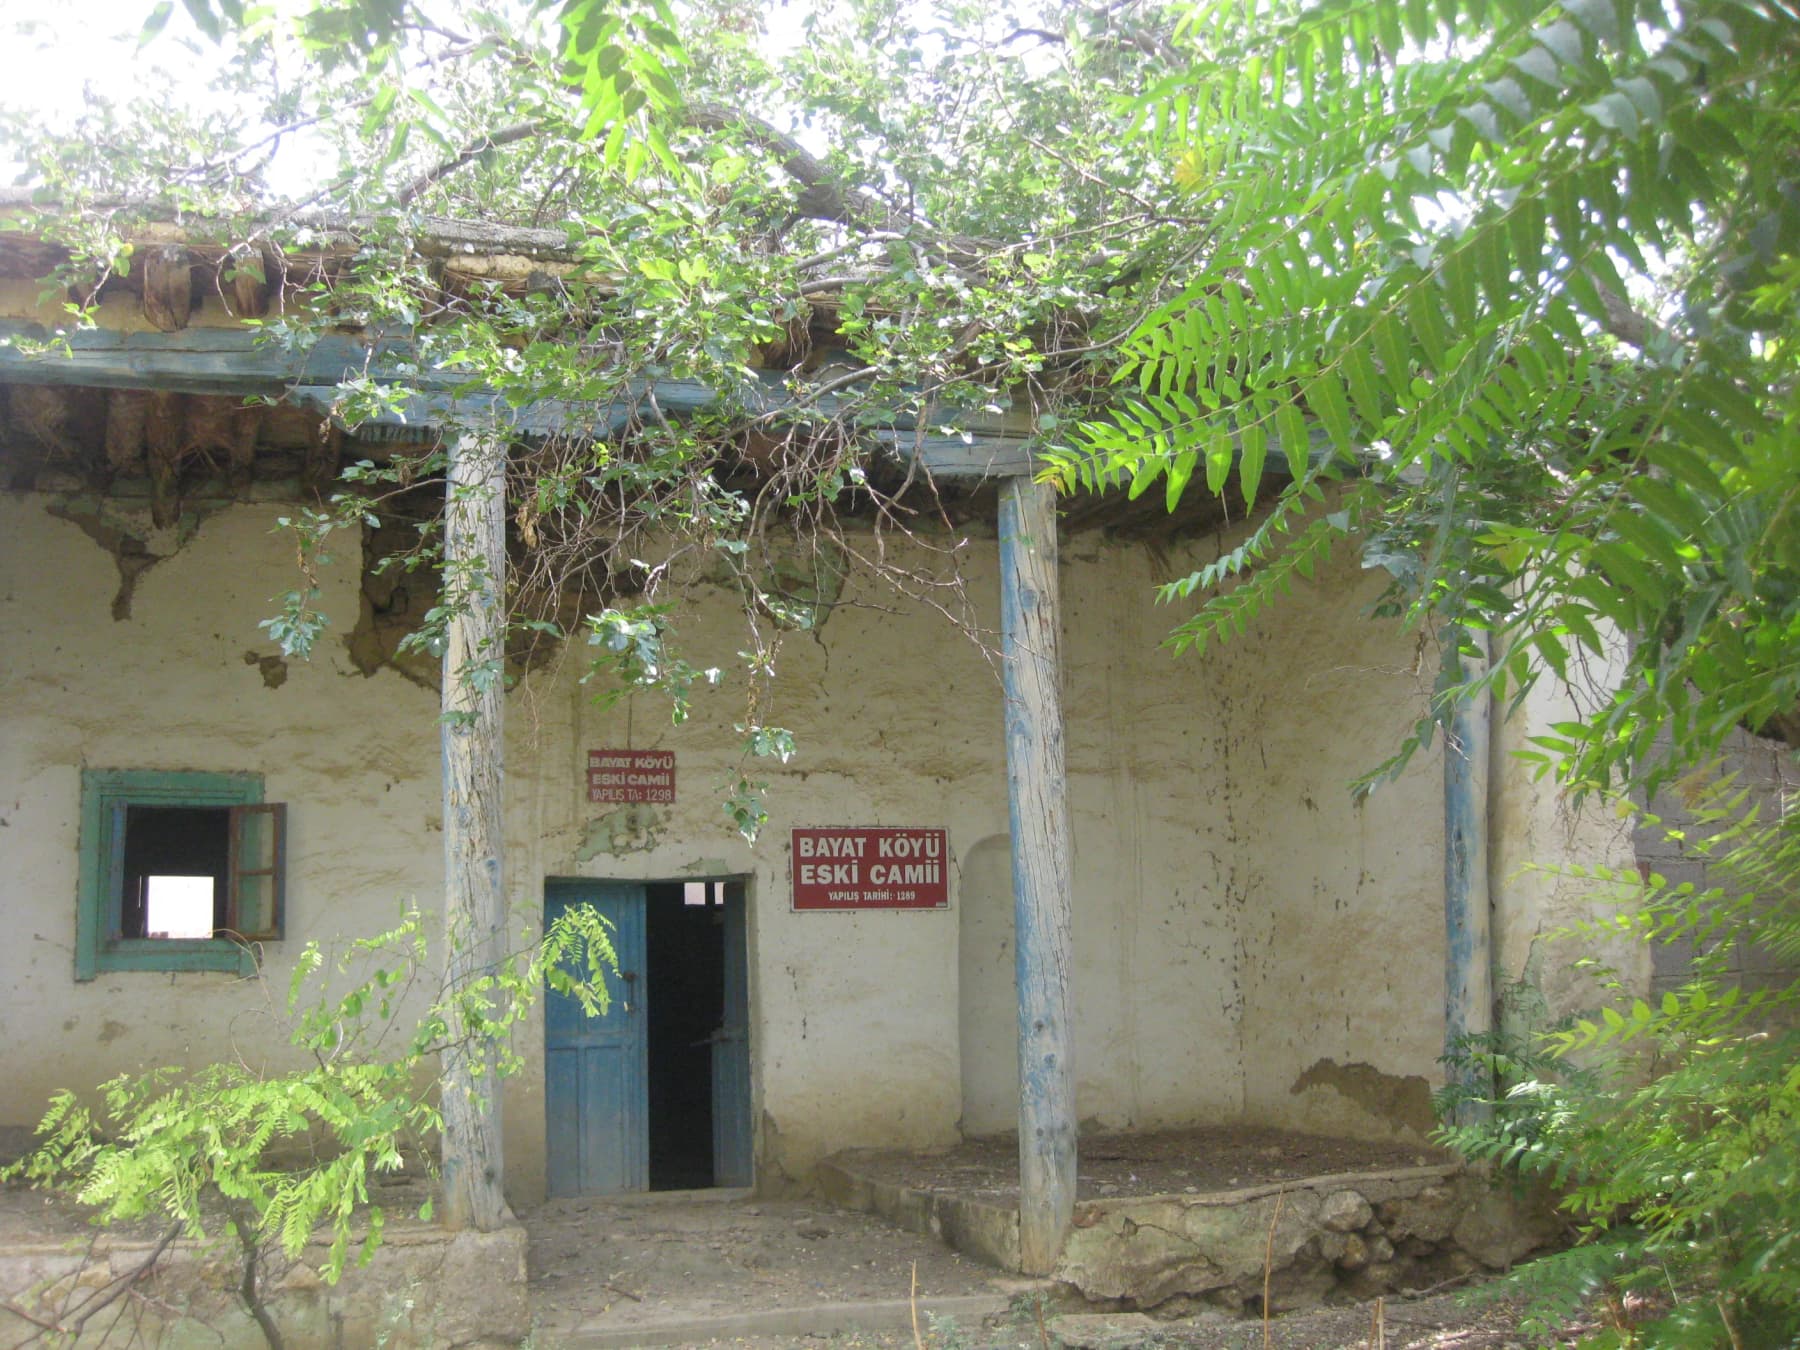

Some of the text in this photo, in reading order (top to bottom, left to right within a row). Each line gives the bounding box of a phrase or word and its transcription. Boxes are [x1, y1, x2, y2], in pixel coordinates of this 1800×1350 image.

[589, 756, 673, 769] BAYAT KÖYÜ
[592, 772, 625, 785] ESKİ
[646, 789, 672, 801] 1298
[800, 833, 940, 857] BAYAT KÖYÜ
[801, 860, 940, 884] ESKİ CAMİİ
[828, 891, 859, 902] YAPILIŞ
[863, 889, 893, 901] TARİHİ:
